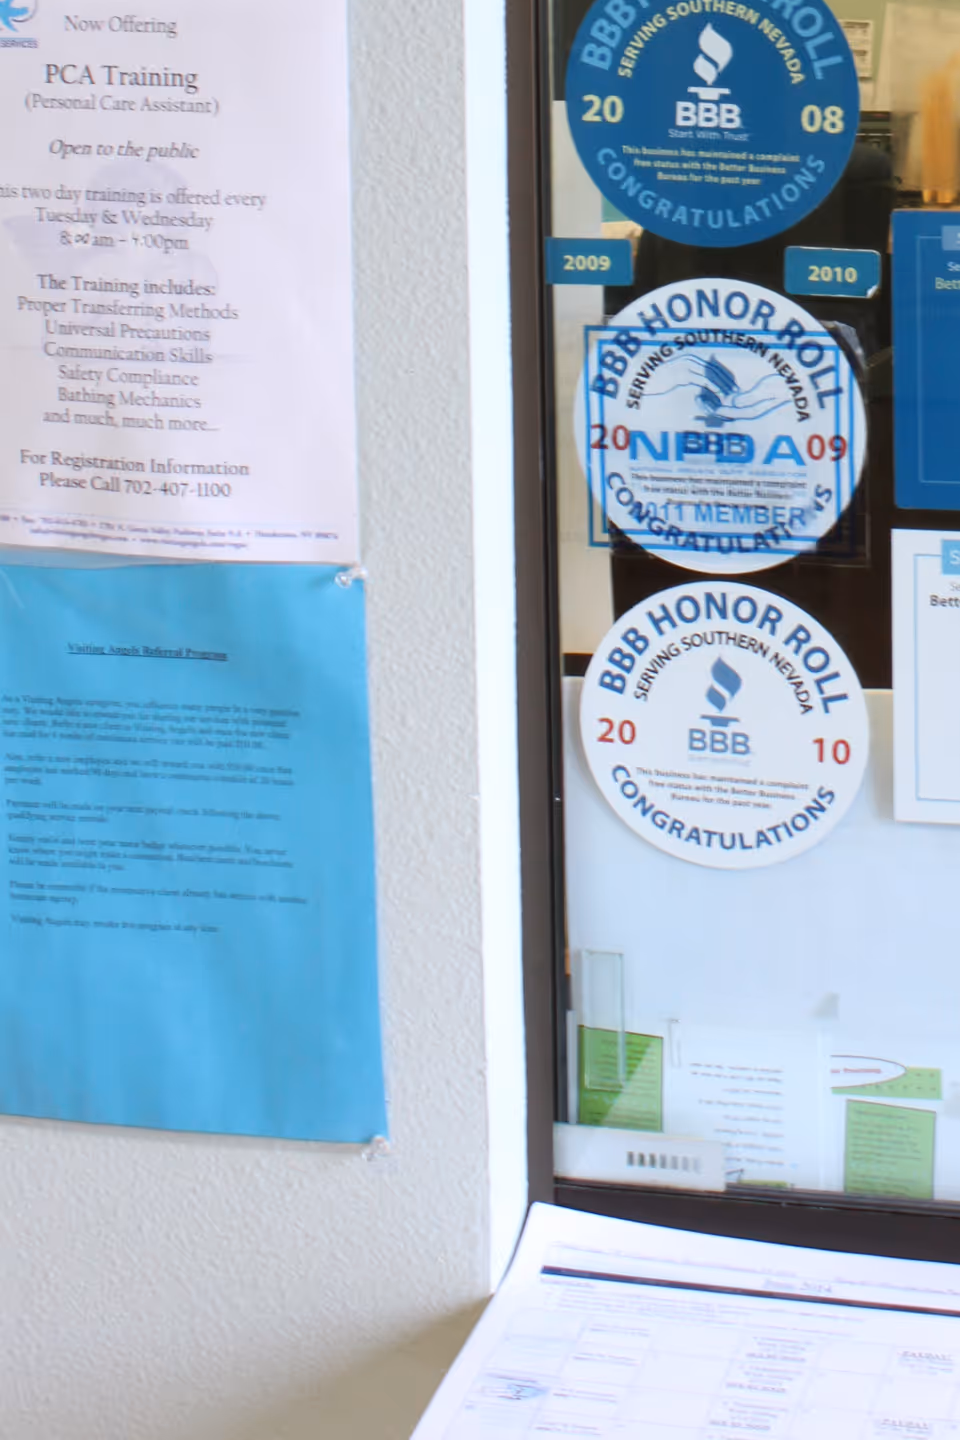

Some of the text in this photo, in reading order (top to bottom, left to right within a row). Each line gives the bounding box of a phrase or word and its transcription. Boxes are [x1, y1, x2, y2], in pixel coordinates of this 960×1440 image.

[64, 15, 177, 38] Now Offering
[618, 15, 667, 78] SERVING
[758, 19, 805, 84] NEVADA
[45, 64, 199, 94] PCA Training
[24, 92, 219, 114] (Personal Care Assistant)
[582, 95, 623, 123] 20
[675, 102, 741, 128] BBB
[801, 105, 844, 134] 08
[50, 139, 199, 161] Open to the public
[597, 147, 826, 230] CONGRATULATIONS
[34, 207, 214, 231] Tuesday & Wednesday
[563, 255, 610, 271] 2009
[808, 266, 857, 282] 2010
[37, 274, 215, 298] The Training includes:
[18, 296, 239, 321] Proper Transferring Methods
[45, 320, 210, 341] Universal Precautions
[44, 342, 213, 363] Communication Skills
[590, 288, 843, 410] BBB HONOR ROLL
[58, 365, 199, 388] Safety Compliance
[627, 330, 811, 422] SERVING SOUTHERN NEVADA
[58, 387, 201, 408] Bathing Mechanics
[590, 424, 630, 451] 20
[807, 435, 847, 461] 09
[20, 449, 249, 475] For Registration Information
[40, 473, 232, 497] Please Call 702-407-1100
[598, 592, 849, 714] BBB HONOR ROLL
[634, 631, 813, 715] SERVING SOUTHERN NEVADA
[597, 718, 636, 744] 20
[689, 728, 750, 756] BBB
[813, 738, 850, 764] 10
[612, 765, 834, 850] CONGRATULATIONS
